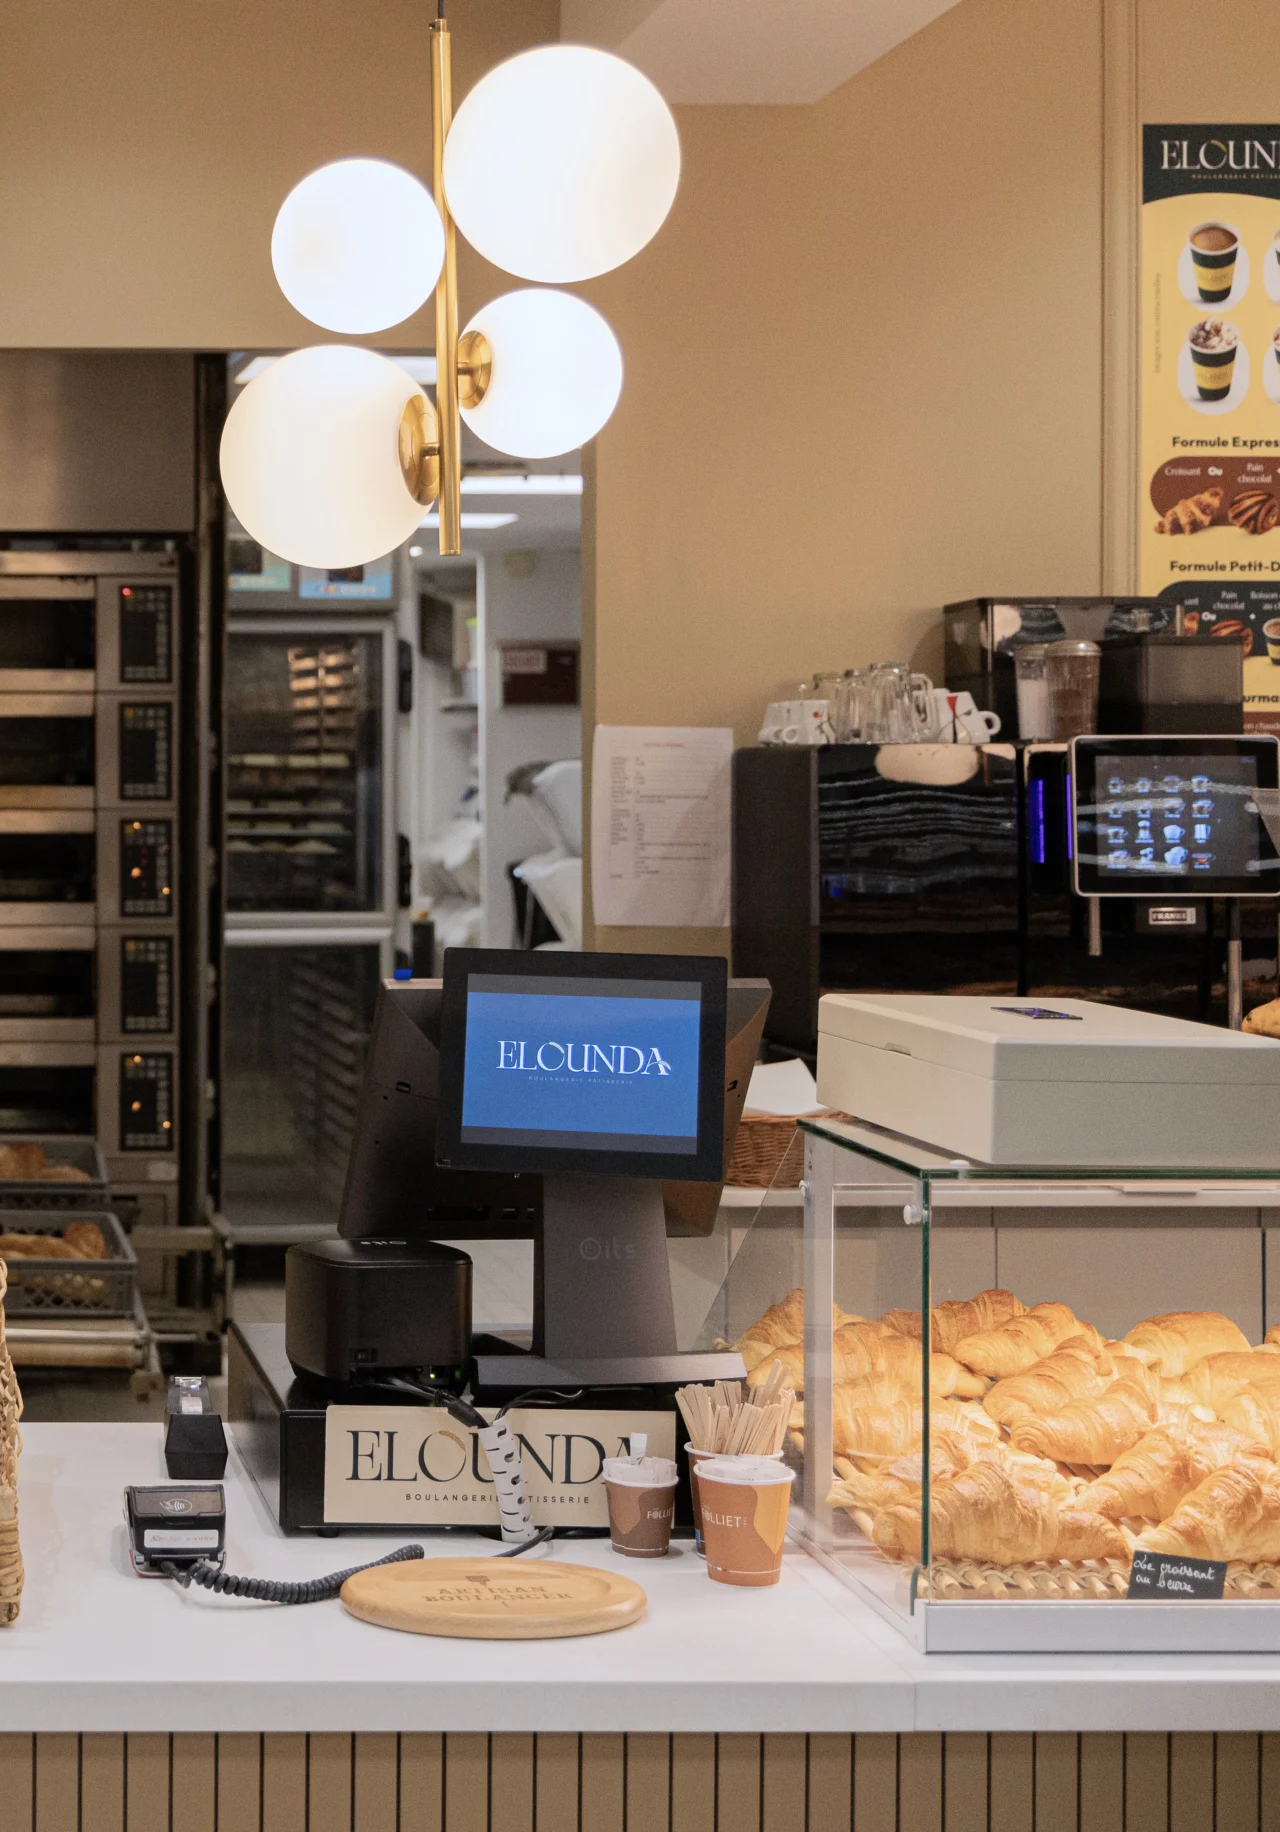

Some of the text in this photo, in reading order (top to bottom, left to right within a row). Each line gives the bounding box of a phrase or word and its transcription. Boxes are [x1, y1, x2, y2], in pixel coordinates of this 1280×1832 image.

[1160, 139, 1280, 169] ELOUN
[1171, 436, 1229, 448] Formule
[1164, 466, 1201, 476] Croissant
[1246, 462, 1264, 473] Pain
[1237, 474, 1272, 483] chocolat
[1170, 560, 1227, 572] Formule
[496, 1040, 671, 1076] ELOUNDA
[528, 1075, 584, 1083] BOULANGERIE
[345, 1429, 632, 1485] ELOUND
[527, 1495, 590, 1504] TISSERIE
[646, 1508, 674, 1520] FOLLIE
[1133, 1554, 1215, 1580] Le croissant
[1135, 1573, 1151, 1585] au
[424, 1593, 574, 1602] BOULANGER
